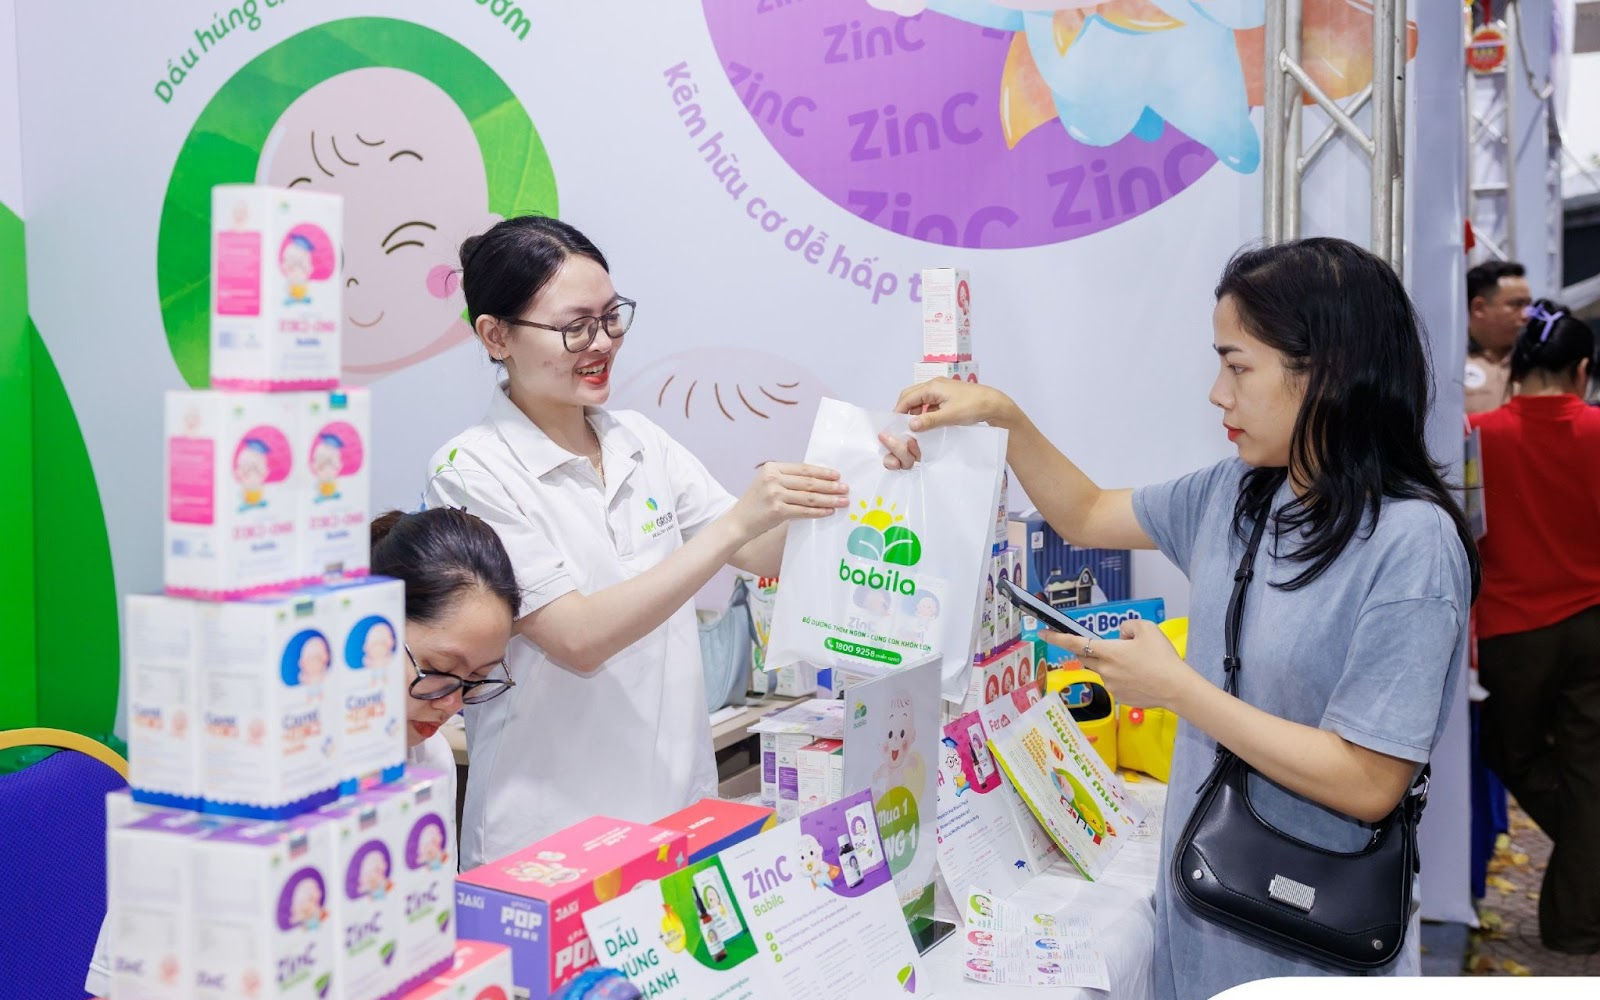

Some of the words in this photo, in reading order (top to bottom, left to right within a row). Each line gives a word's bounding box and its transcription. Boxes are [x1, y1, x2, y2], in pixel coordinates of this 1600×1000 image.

[194, 0, 261, 53] húng
[823, 13, 926, 64] ZinC
[847, 92, 984, 163] ZinC
[663, 61, 707, 138] Kẽm
[698, 131, 749, 201] hữu
[746, 197, 789, 232] cơ
[784, 224, 829, 264] dễ
[828, 244, 899, 305] hấp
[1046, 140, 1208, 229] ZinC
[838, 557, 916, 597] babila
[835, 641, 854, 653] 1800
[855, 645, 876, 658] 9258
[903, 797, 908, 816] 1
[909, 823, 916, 849] 1
[742, 855, 793, 900] ZinC
[500, 905, 542, 930] POP
[753, 894, 785, 917] Babila
